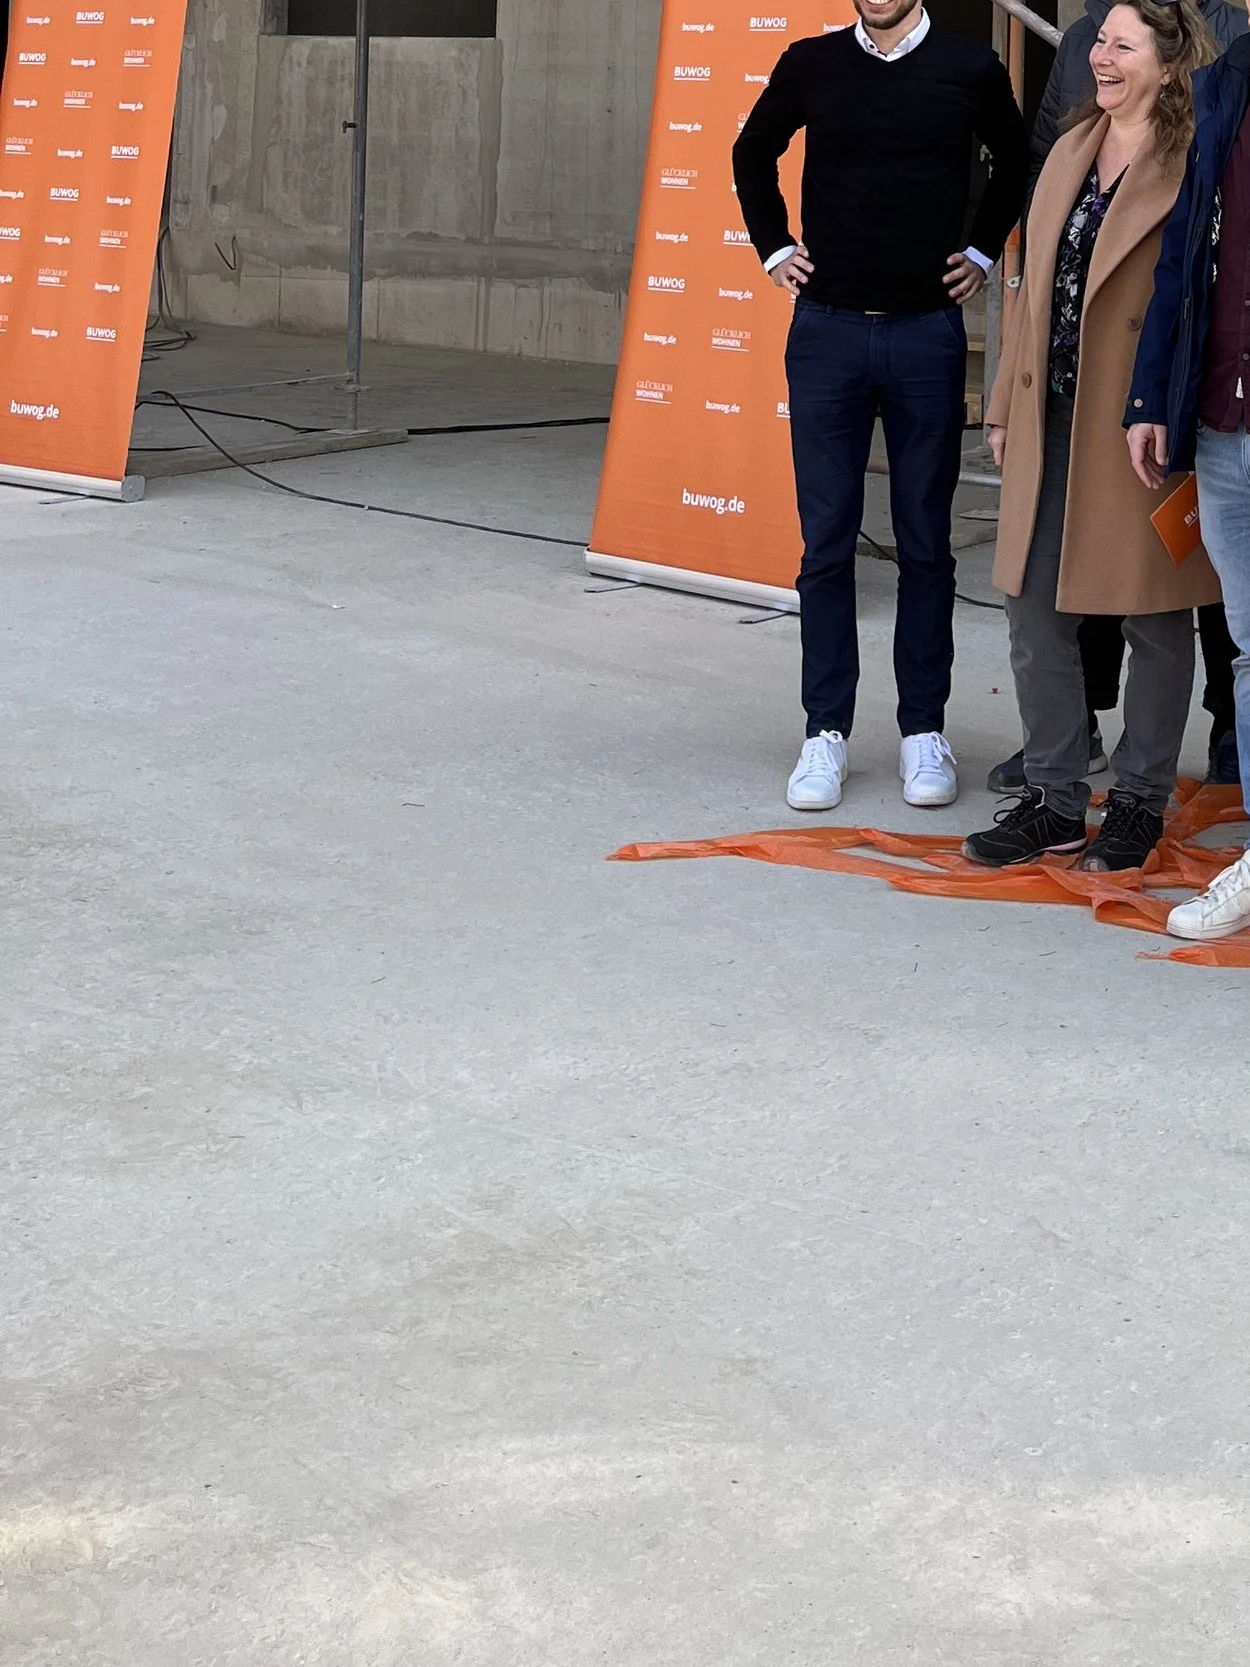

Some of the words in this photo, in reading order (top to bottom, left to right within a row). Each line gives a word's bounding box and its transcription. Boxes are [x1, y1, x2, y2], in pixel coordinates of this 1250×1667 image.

[76, 11, 104, 21] BUWOG
[750, 17, 787, 28] BUWOG
[19, 52, 46, 62] BUWOG
[674, 66, 711, 77] BUWOG
[111, 145, 139, 156] BUWOG
[50, 187, 79, 198] BUWOG
[656, 231, 688, 244] buwog.de
[648, 276, 686, 289] BUWOG
[718, 287, 753, 301] buwog.de
[86, 327, 116, 339] BUWOG
[643, 332, 677, 346] buwog.de
[712, 337, 741, 348] WOHNEN
[10, 399, 60, 419] buwog.de
[705, 400, 741, 415] buwog.de
[682, 488, 745, 515] buwog.de
